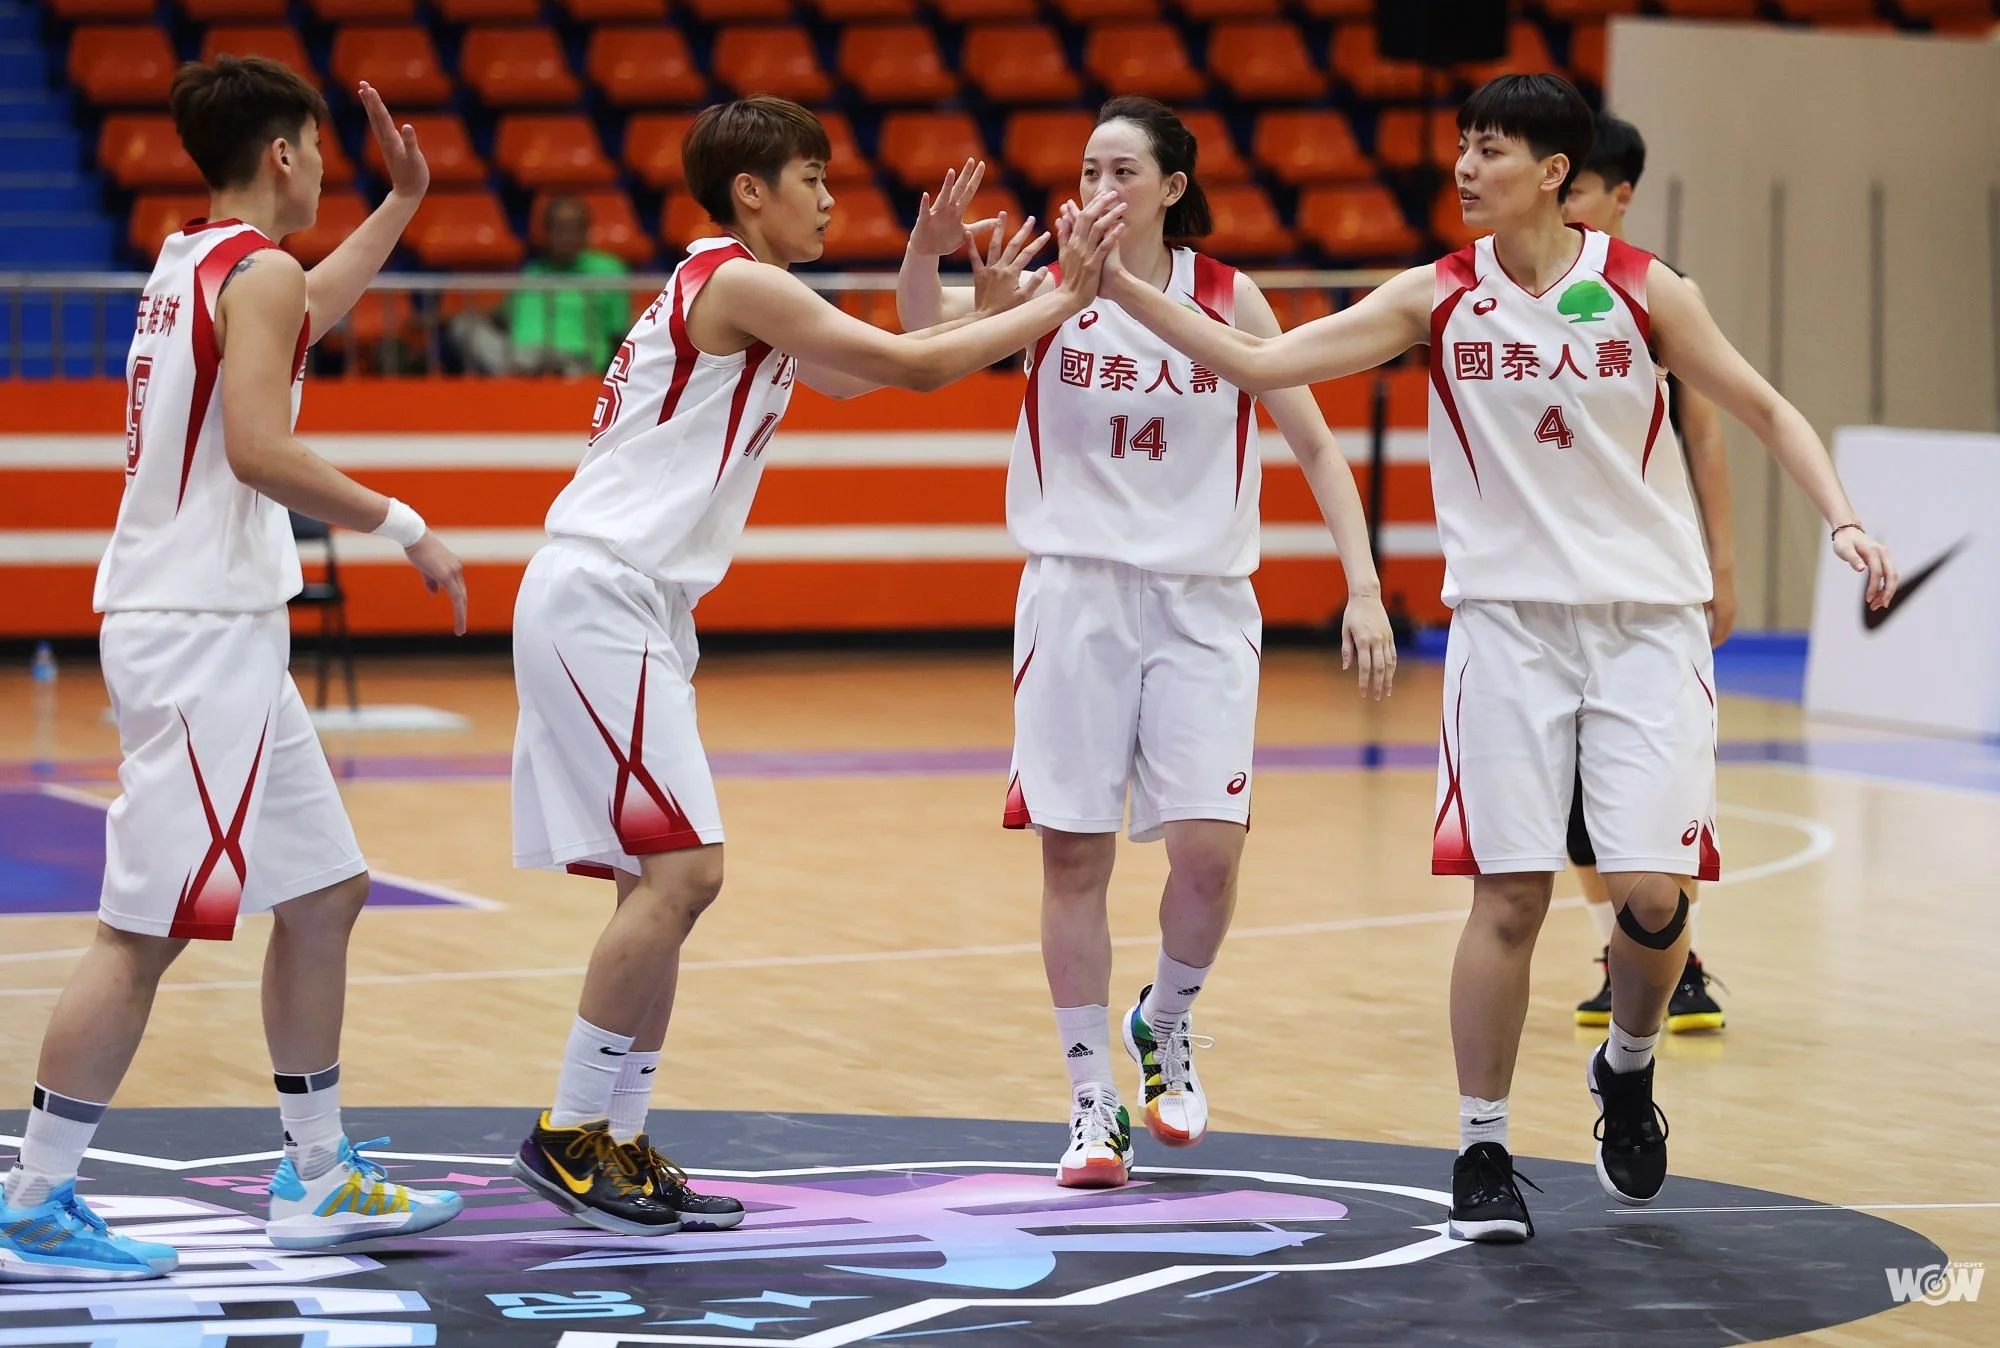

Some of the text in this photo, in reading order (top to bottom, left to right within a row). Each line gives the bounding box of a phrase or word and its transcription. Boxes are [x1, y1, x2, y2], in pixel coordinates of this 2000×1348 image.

[1060, 346, 1219, 396] 國泰人壽
[1453, 339, 1633, 381] 國泰人壽
[1110, 414, 1167, 461] 14
[1533, 405, 1574, 450] 4
